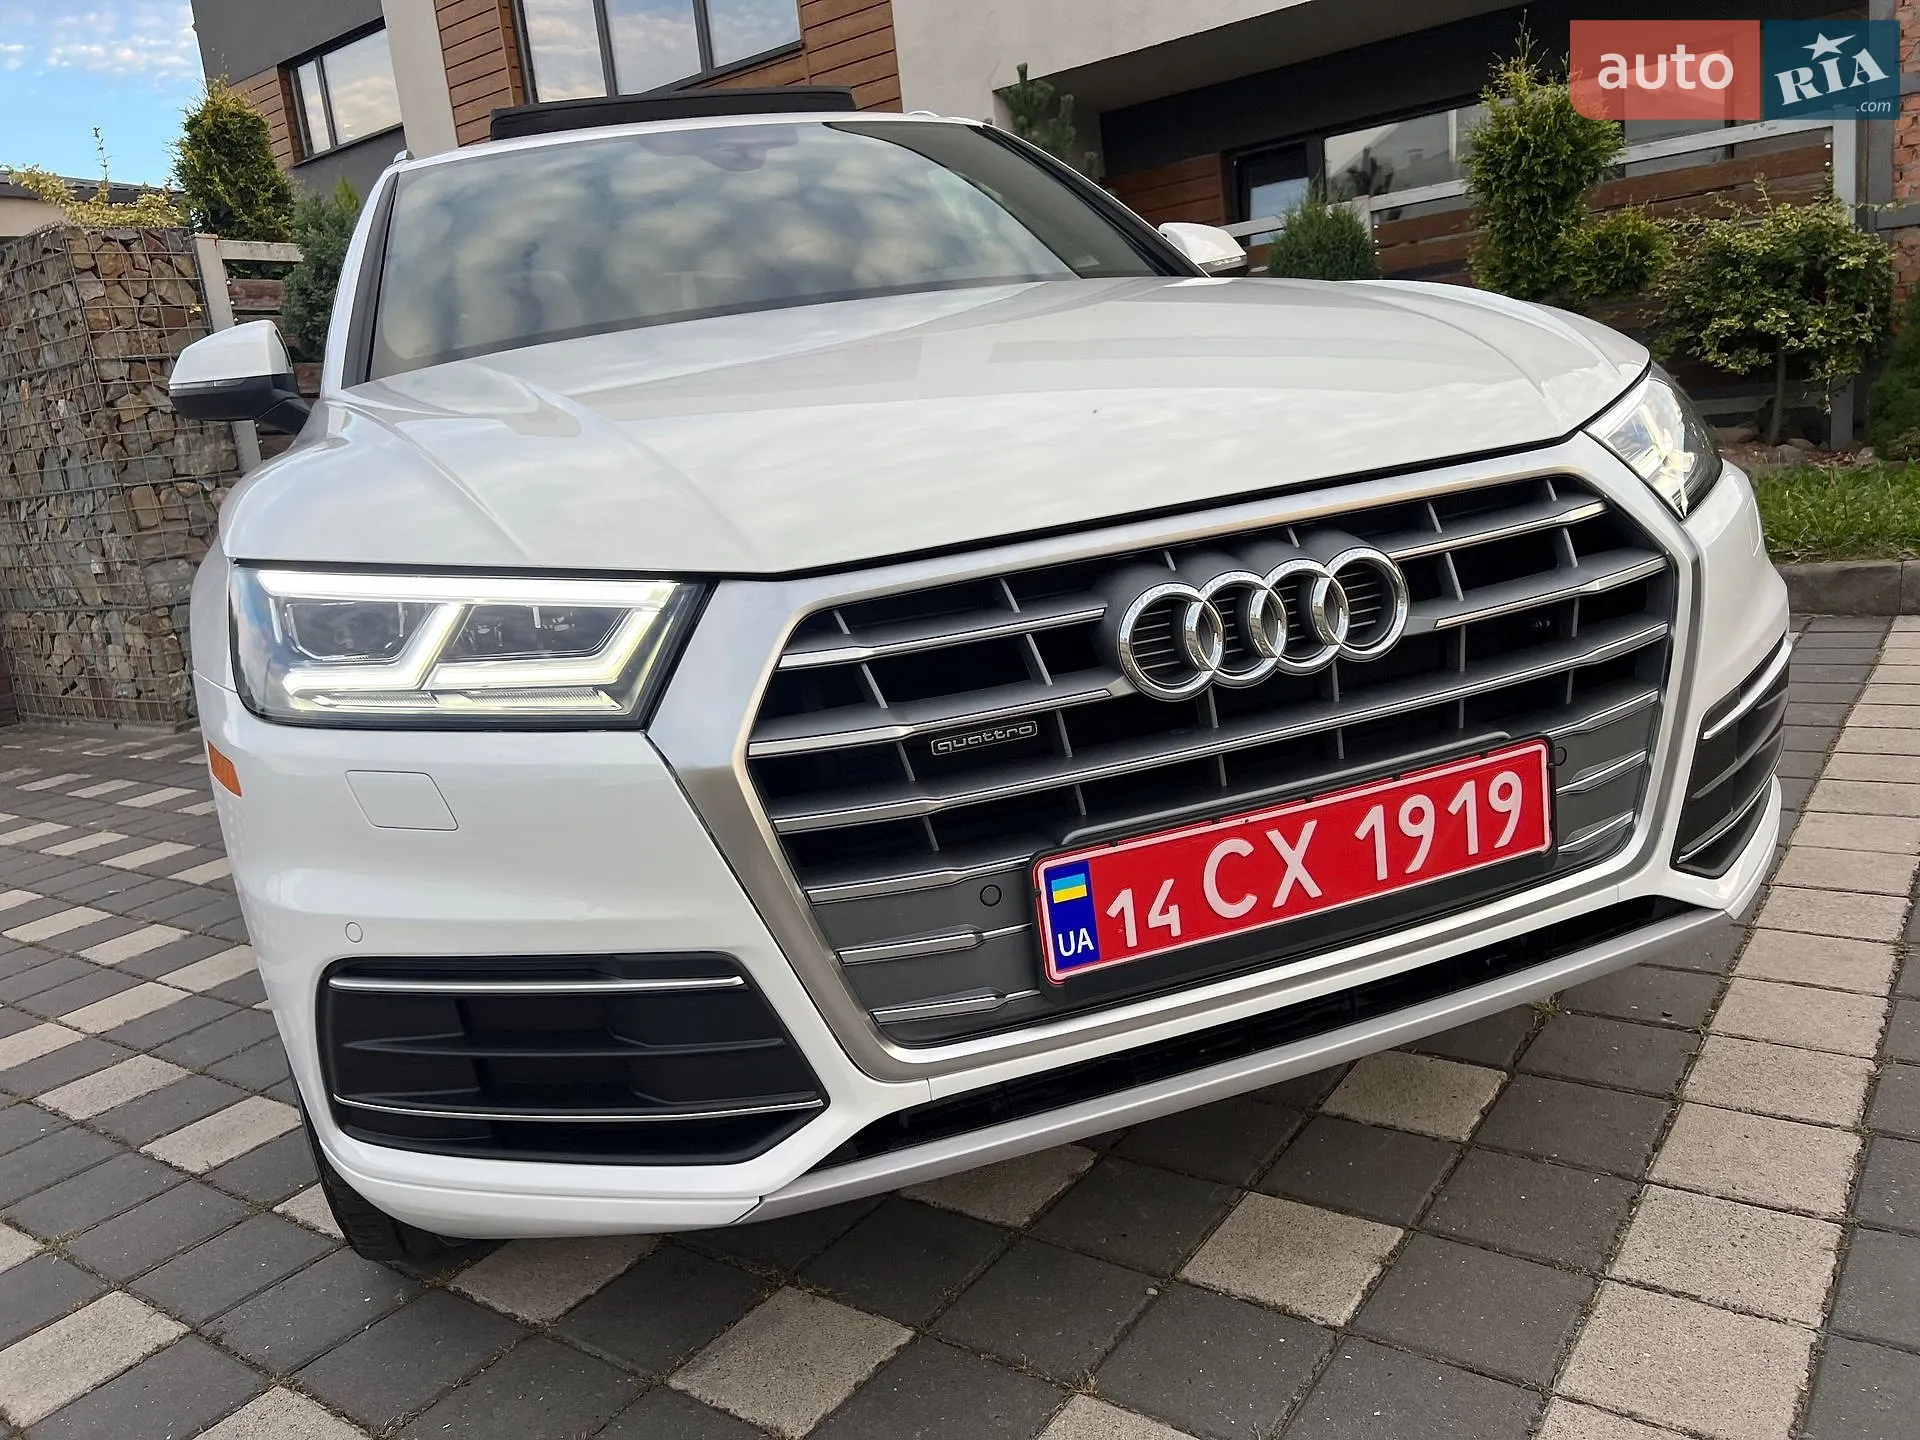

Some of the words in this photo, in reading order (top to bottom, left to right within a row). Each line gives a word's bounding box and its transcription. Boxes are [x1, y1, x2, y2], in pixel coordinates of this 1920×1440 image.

[937, 725, 1033, 752] quattro
[1106, 878, 1182, 948] 14
[1203, 820, 1323, 919] CX
[1354, 770, 1523, 881] 1919
[1057, 927, 1095, 957] UA
